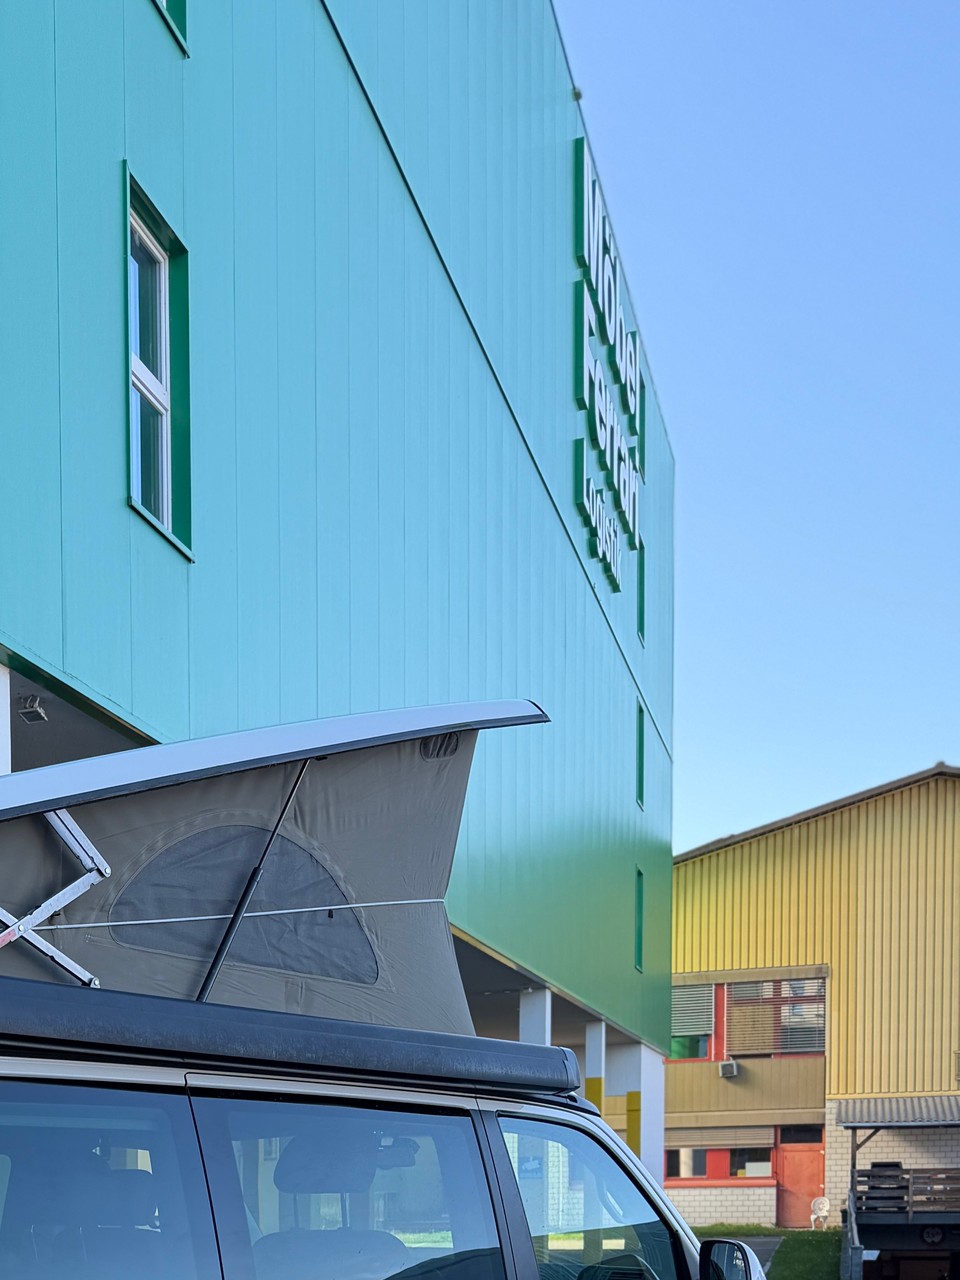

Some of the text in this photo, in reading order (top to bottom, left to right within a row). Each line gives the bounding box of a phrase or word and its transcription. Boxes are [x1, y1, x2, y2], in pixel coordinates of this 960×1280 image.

[579, 137, 640, 436] Möbel
[579, 278, 640, 550] Ferrari
[579, 438, 622, 592] Logistik
